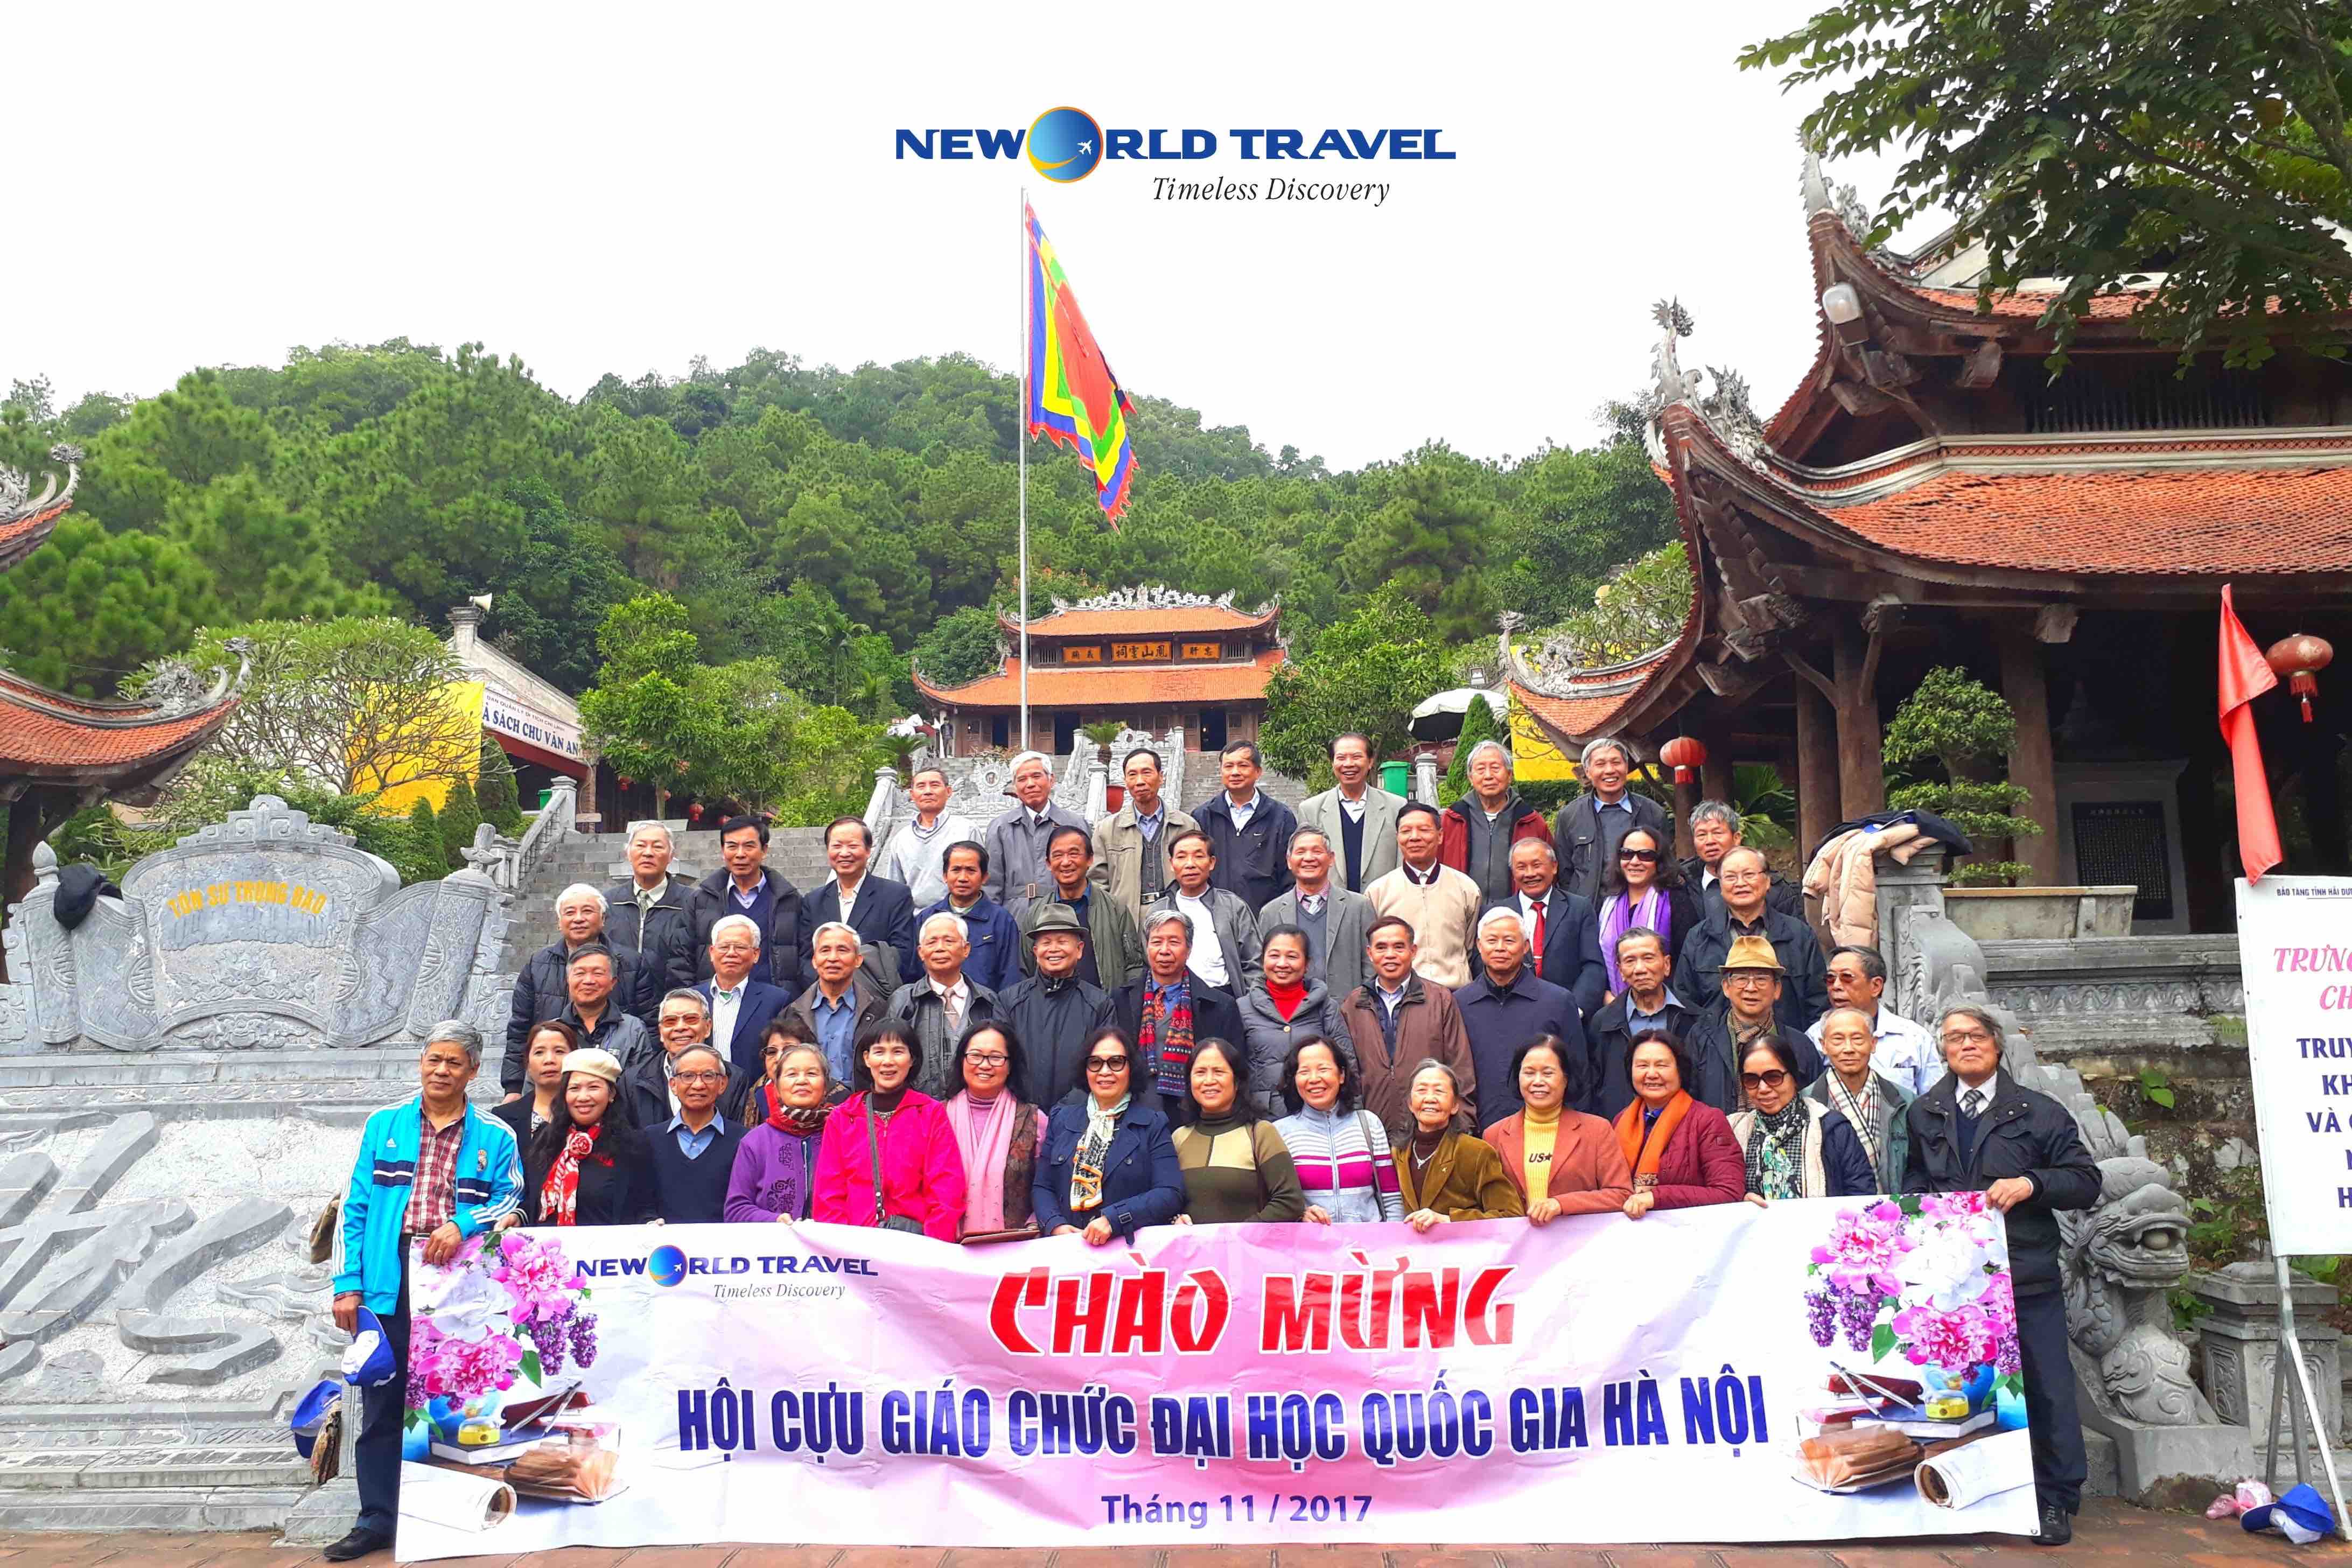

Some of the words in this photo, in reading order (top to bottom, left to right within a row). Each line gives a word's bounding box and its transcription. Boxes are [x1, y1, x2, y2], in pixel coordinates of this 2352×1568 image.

[493, 709, 520, 733] SÁCH
[523, 723, 542, 742] CHU
[544, 730, 564, 750] VĂN
[566, 741, 578, 756] AN
[2306, 1107, 2342, 1132] VÀ
[758, 1256, 878, 1276] TRAVEL
[713, 1283, 771, 1297] Timeless
[776, 1284, 845, 1299] Discovery
[990, 1252, 1229, 1353] CHÀO
[1262, 1250, 1516, 1350] MỪNG
[677, 1377, 755, 1461] HỘI
[771, 1381, 863, 1463] CỰU
[880, 1379, 989, 1457] GIÁO
[1010, 1382, 1136, 1456] CHỨC
[1151, 1396, 1232, 1470] ĐẠI
[1248, 1395, 1345, 1472] HỌC
[1362, 1369, 1493, 1468] QUỐC
[1509, 1387, 1587, 1452] GIA
[1604, 1369, 1669, 1446] HÀ
[1681, 1363, 1769, 1457] NỘI
[1101, 1494, 1208, 1529] Tháng
[1221, 1495, 1254, 1523] 11
[1289, 1495, 1373, 1523] 2017
